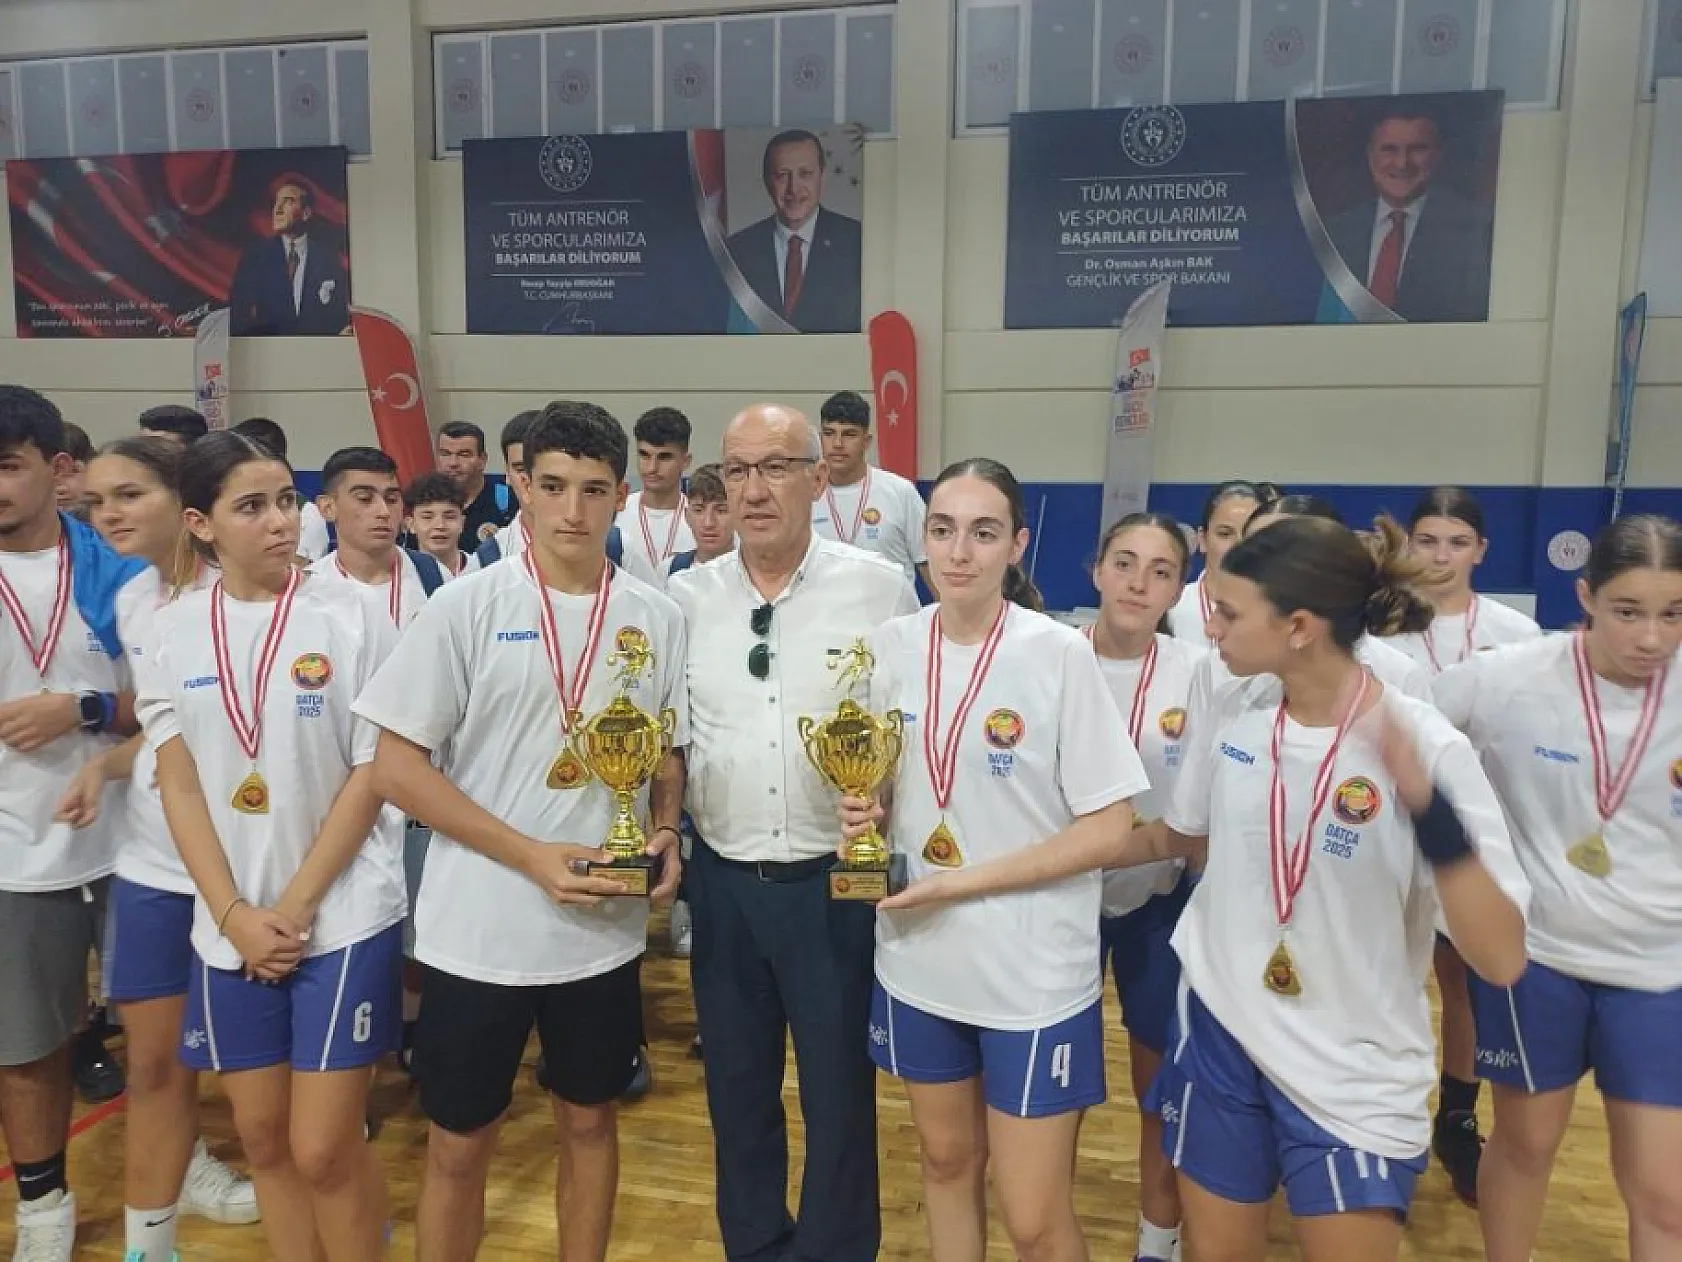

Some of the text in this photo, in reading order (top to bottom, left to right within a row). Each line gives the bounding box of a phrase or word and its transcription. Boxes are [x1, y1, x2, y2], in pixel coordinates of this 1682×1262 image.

[1080, 179, 1228, 202] TÜM ANTRENÖR
[508, 208, 629, 227] TÜM ANTRENÖR
[1058, 205, 1247, 226] VE SPORCULARIMIZA
[492, 231, 647, 249] VE SPORCULARIMIZA
[1061, 226, 1240, 248] BAŞARILAR DİLİYORUM
[496, 249, 641, 268] BAŞARILAR DİLİYORUM
[1084, 254, 1214, 271] Dr. Osman Aşkın BAK
[1066, 270, 1231, 288] GENÇLİK VE SPOR BAKANI
[1322, 838, 1353, 860] 2025
[353, 1001, 372, 1042] 6
[1050, 1043, 1072, 1088] 4
